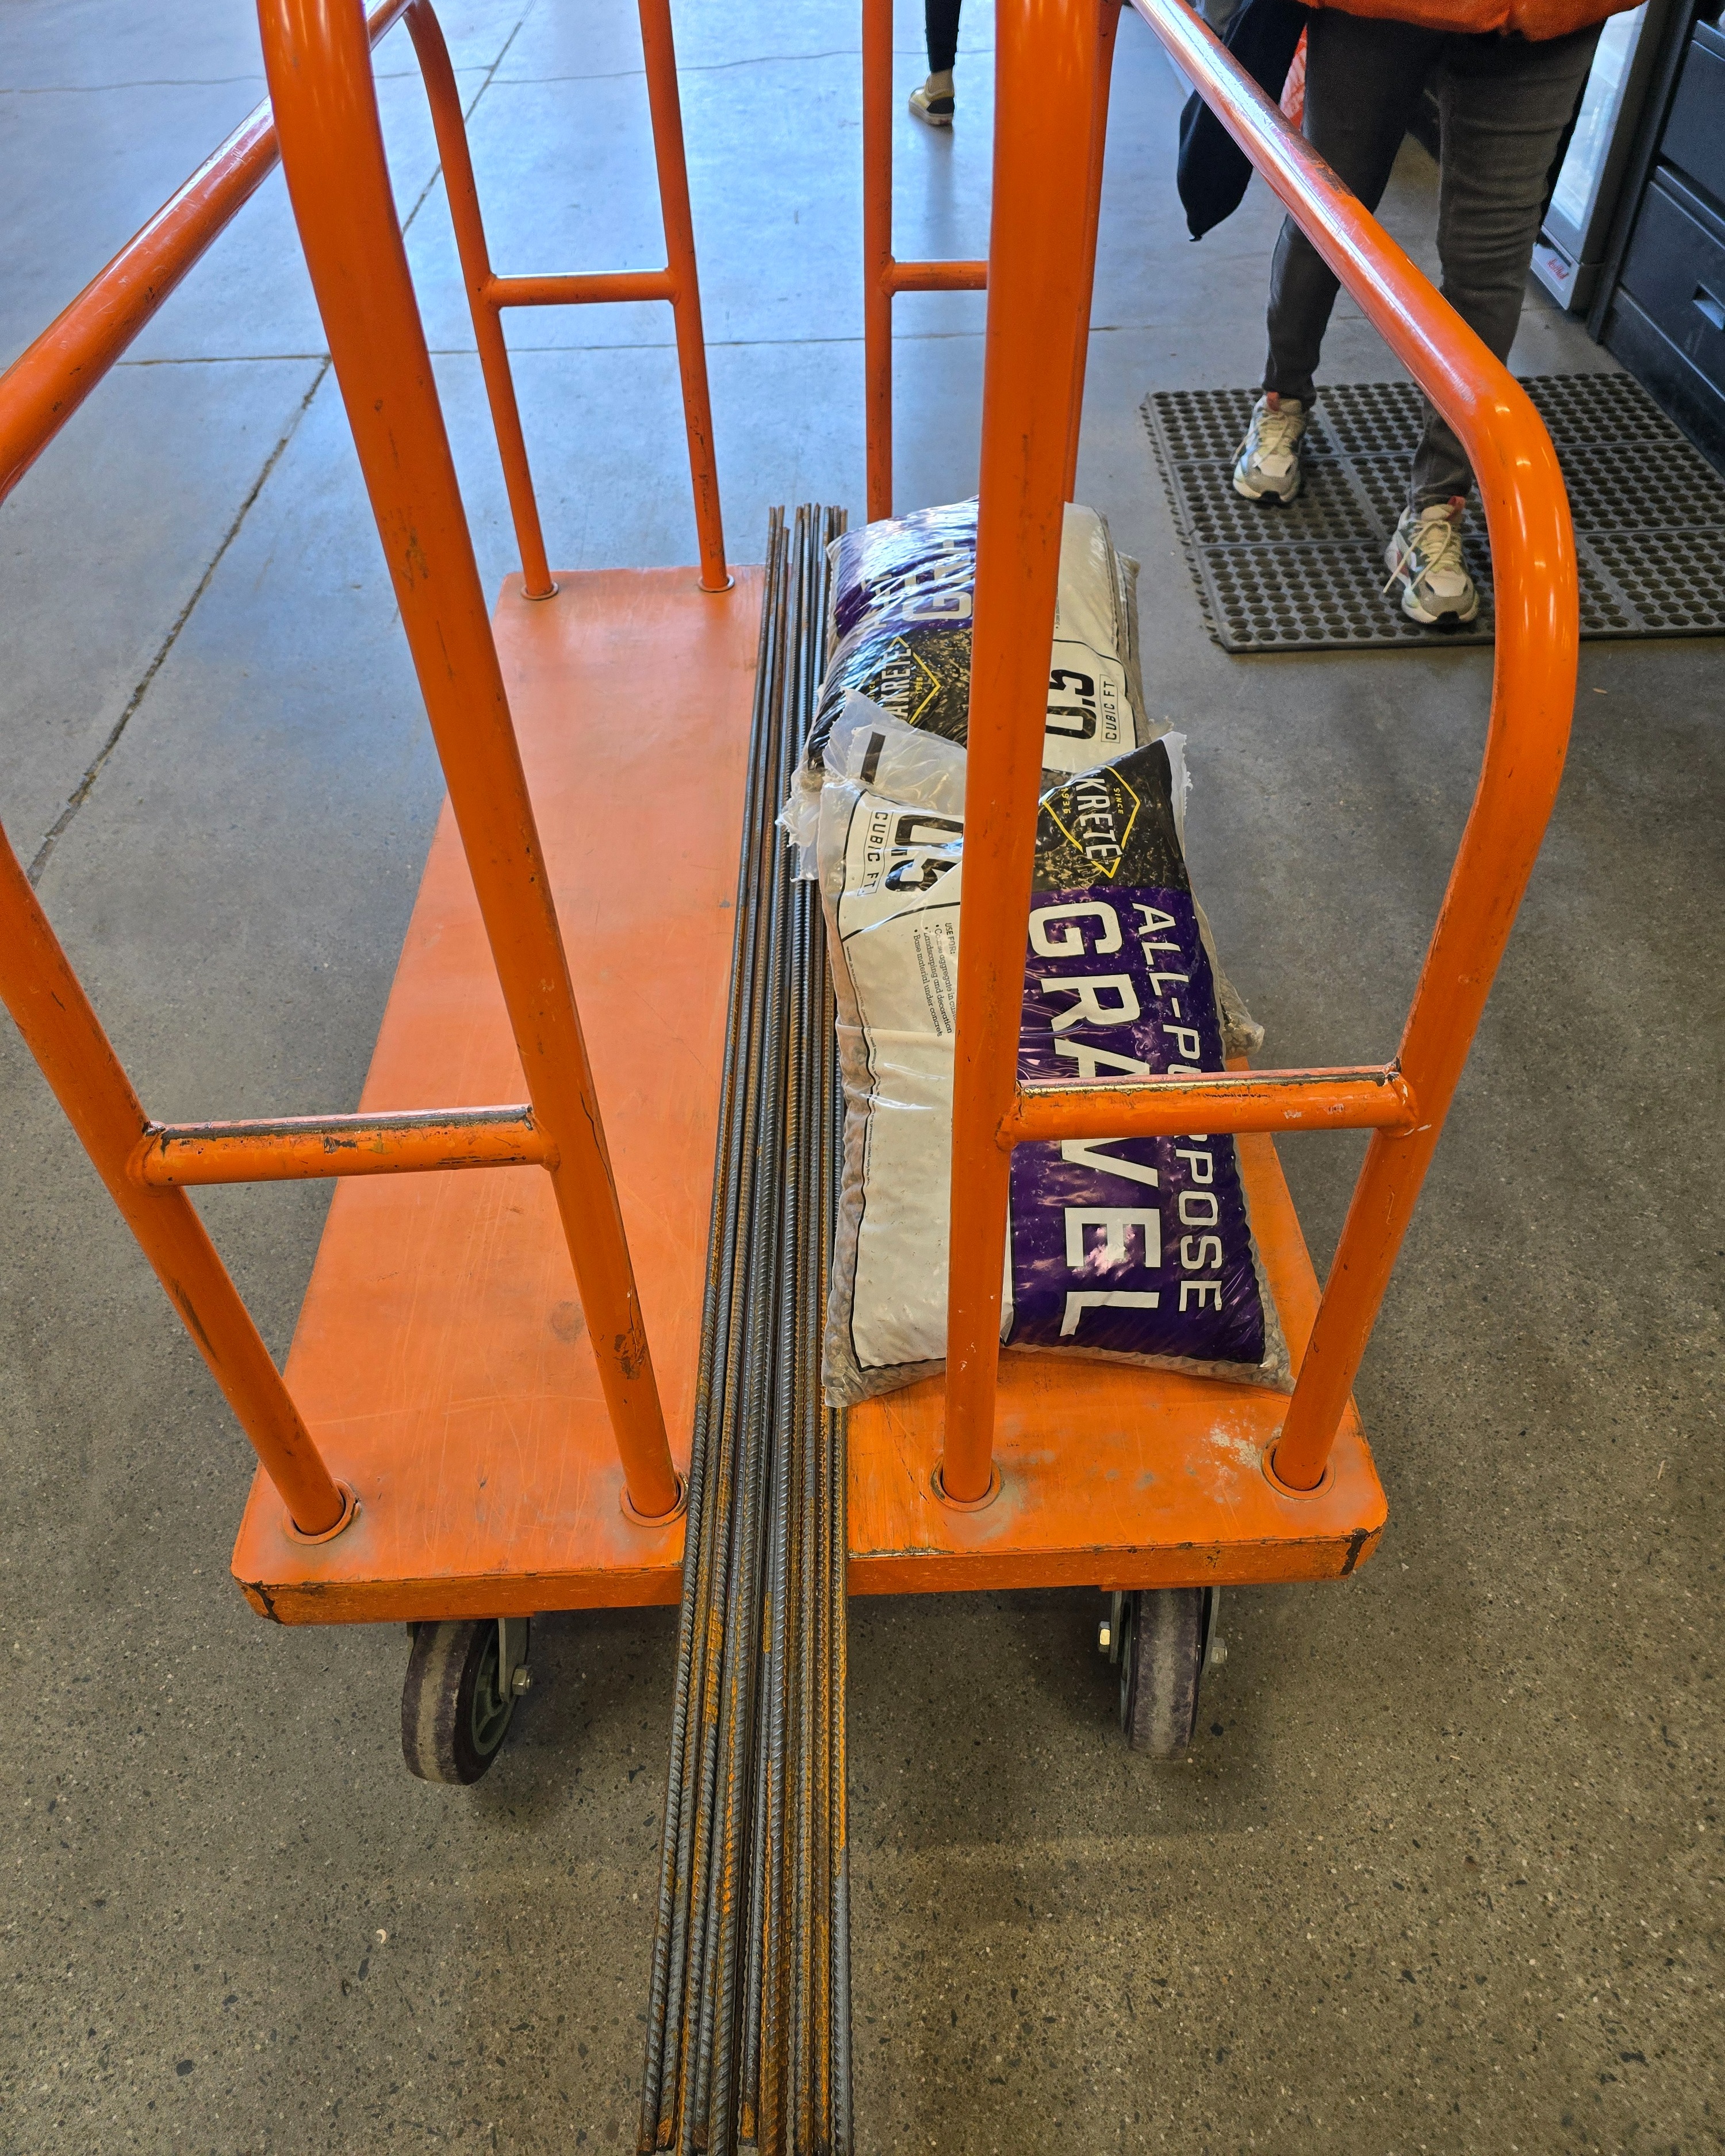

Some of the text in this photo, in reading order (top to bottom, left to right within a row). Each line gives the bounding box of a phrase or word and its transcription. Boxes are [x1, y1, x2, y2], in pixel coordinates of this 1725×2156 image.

[881, 648, 911, 718] AKRETE
[1103, 681, 1117, 741] CUBIC FT
[1060, 787, 1071, 814] 1936
[1076, 778, 1122, 860] KRETE
[1113, 788, 1124, 815] SINCE
[867, 811, 888, 862] CUBIC
[913, 933, 921, 952] Base
[945, 922, 957, 954] USE FOR:
[917, 953, 930, 984] material
[923, 930, 952, 1034] Landscaping and decoration
[940, 954, 952, 992] aggregate
[948, 992, 954, 1000] in
[923, 984, 934, 1007] under
[1028, 901, 1160, 1337] GRAVEL
[1132, 903, 1222, 1311] ALL-PPOSE
